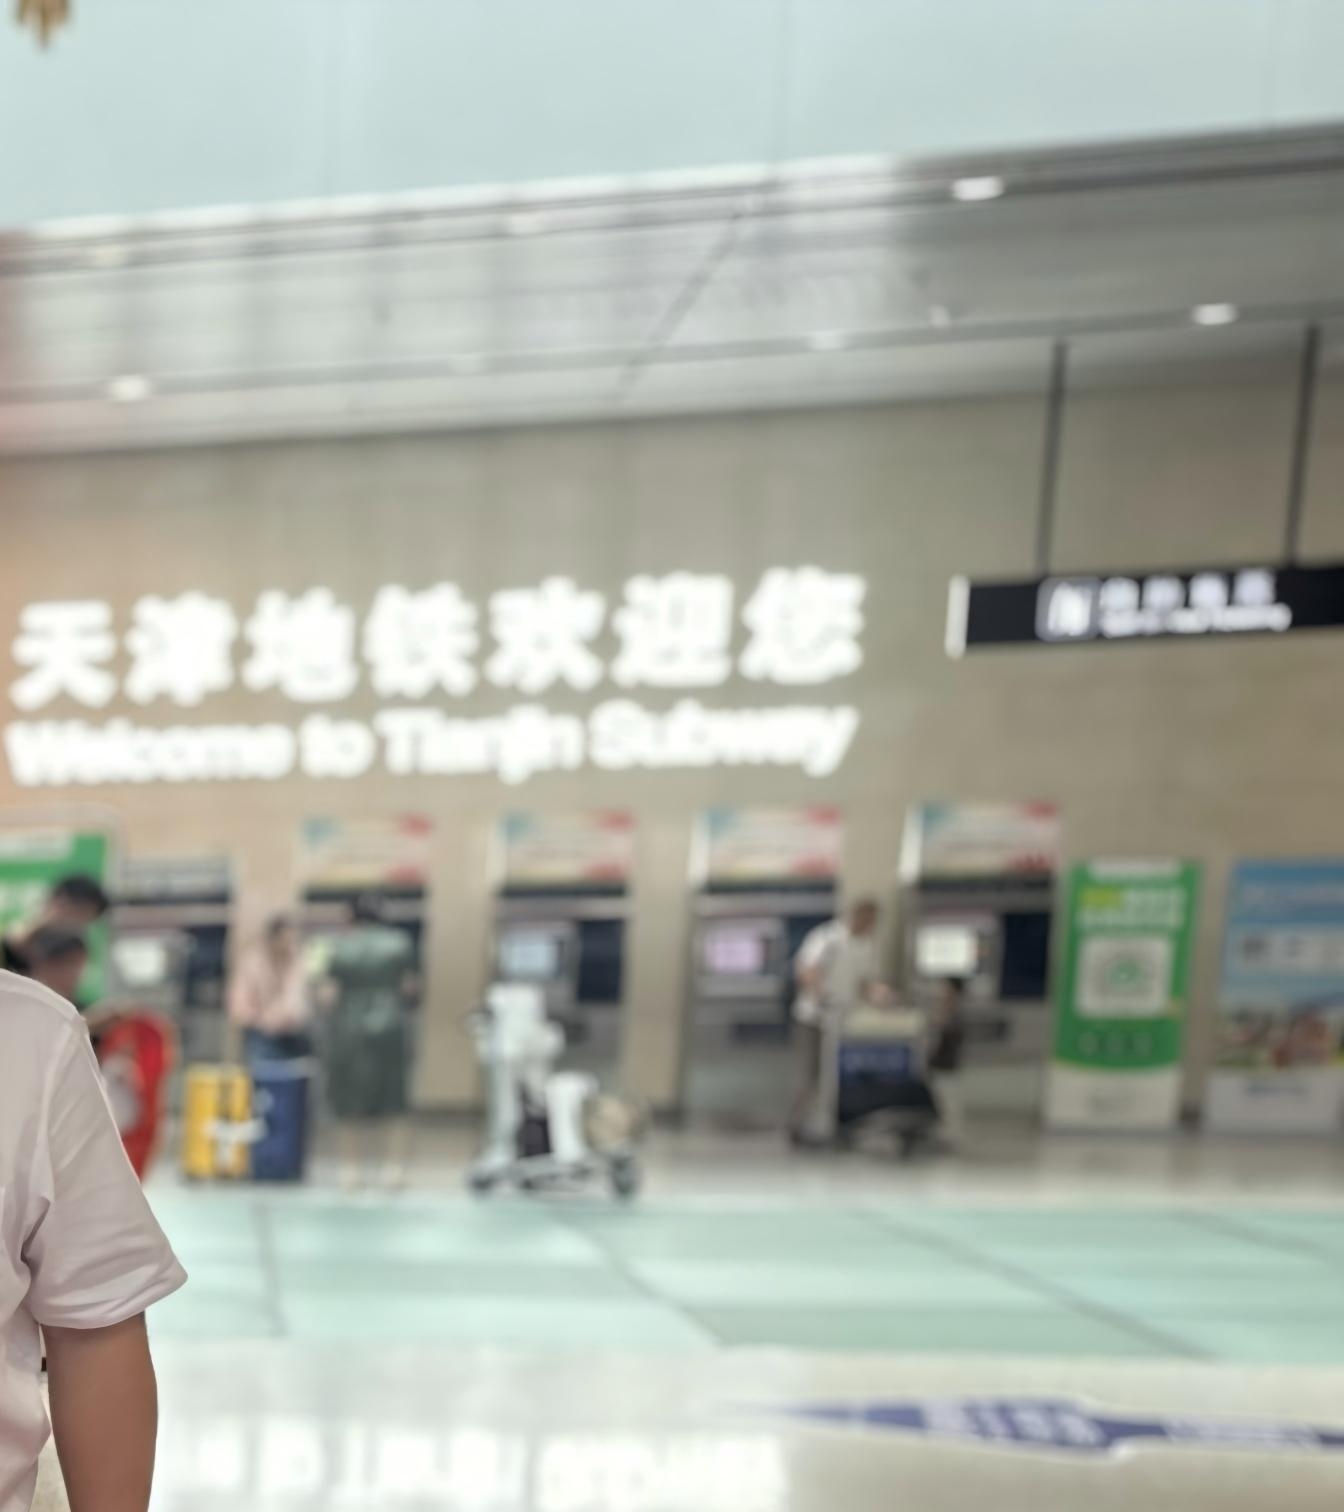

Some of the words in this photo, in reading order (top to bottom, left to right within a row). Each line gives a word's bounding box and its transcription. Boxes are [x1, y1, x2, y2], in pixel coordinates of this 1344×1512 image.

[10, 568, 865, 708] 天津地铁欢迎您
[6, 716, 296, 785] Welcome
[299, 712, 374, 778] to
[375, 705, 585, 784] Tianjin
[588, 698, 859, 777] Subway
